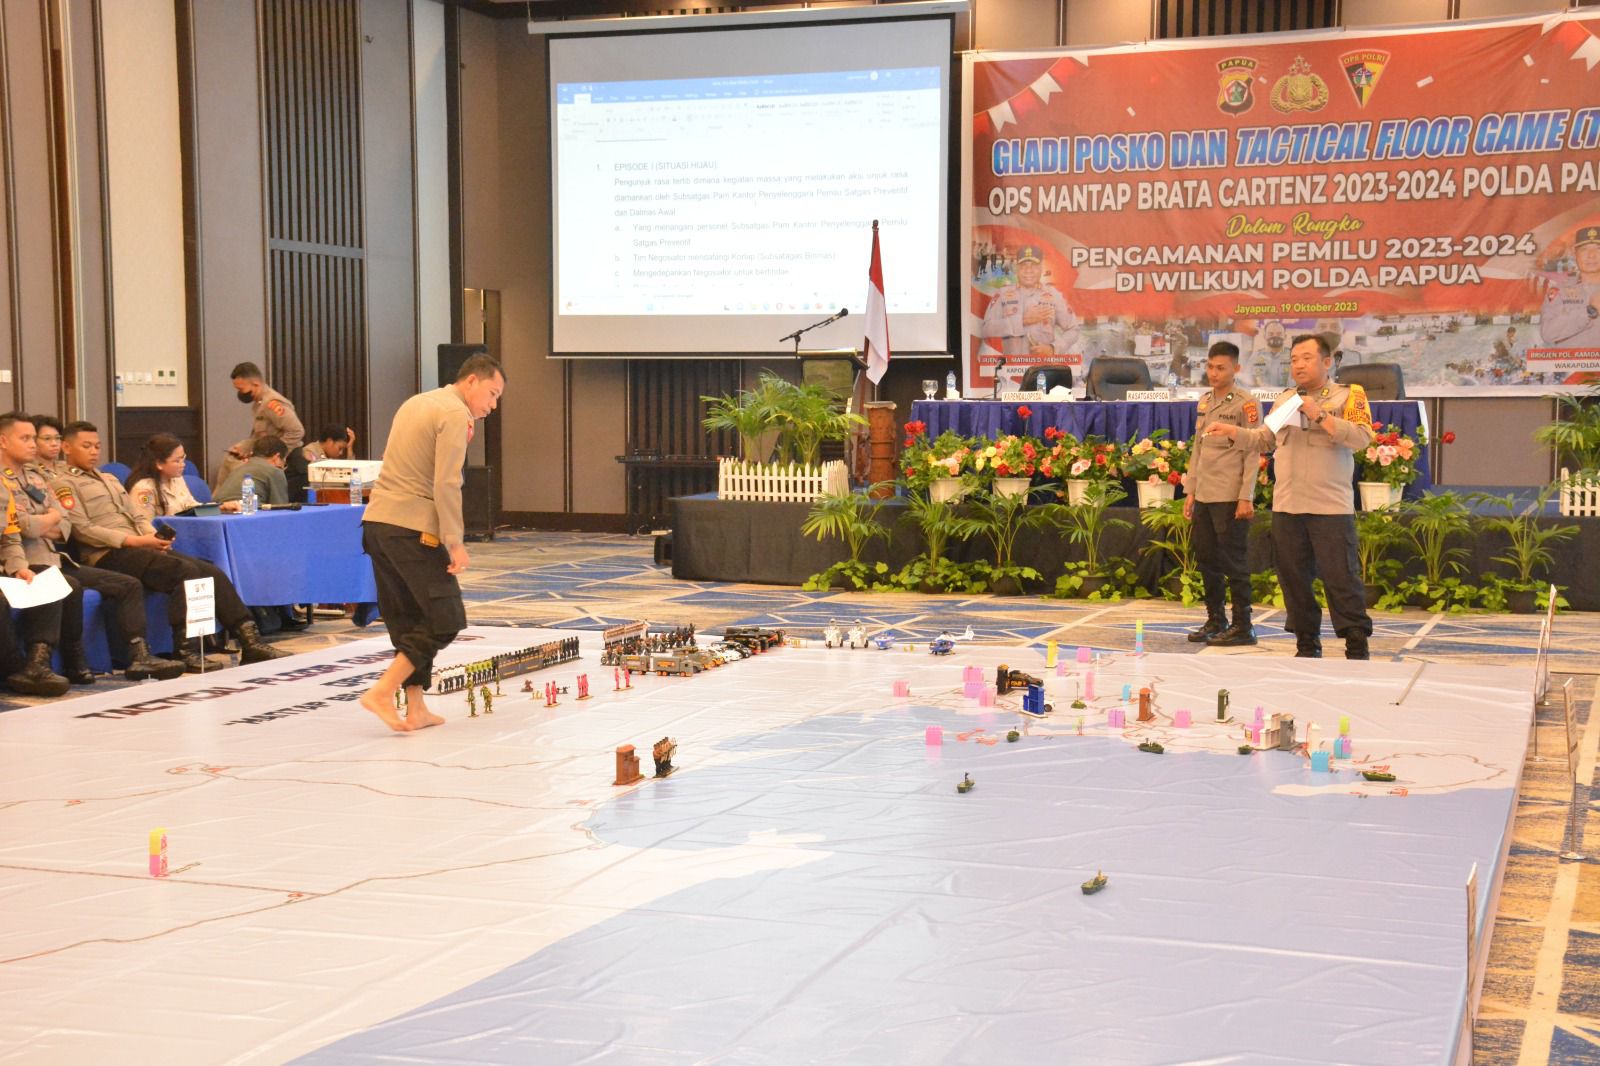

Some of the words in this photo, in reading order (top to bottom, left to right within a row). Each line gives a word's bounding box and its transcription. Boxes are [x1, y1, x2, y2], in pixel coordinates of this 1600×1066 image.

[1362, 53, 1386, 62] POLRI
[1221, 59, 1254, 69] PAPUA
[992, 136, 1070, 176] GLADI
[1074, 132, 1165, 173] POSKO
[1169, 129, 1228, 170] DAN
[1235, 122, 1371, 167] TACTICAL
[1372, 115, 1472, 160] FLOOR
[1473, 109, 1571, 155] GAME
[614, 163, 648, 171] EPISODE
[784, 175, 802, 184] yang
[989, 185, 1032, 215] OPS
[1038, 183, 1131, 213] MANTAP
[1137, 179, 1213, 210] BRATA
[1218, 173, 1328, 208] CARTENZ
[1333, 169, 1456, 203] 2023-2024
[1463, 163, 1553, 198] POLDA
[1561, 160, 1600, 193] PA
[614, 209, 628, 217] dan
[630, 208, 656, 217] Dalmas
[633, 224, 651, 232] Yang
[1226, 213, 1286, 238] Dalam
[1292, 211, 1363, 240] Rangka
[633, 239, 657, 247] Satgas
[1072, 242, 1263, 267] PENGAMANAN
[1272, 239, 1378, 262] PEMILU
[1385, 233, 1536, 260] 2023-2024
[633, 254, 646, 262] Tim
[1116, 272, 1143, 292] DI
[1151, 268, 1264, 291] WILKUM
[1272, 266, 1371, 289] POLDA
[1379, 263, 1481, 286] PAPUA
[1235, 304, 1278, 315] Jayapura,
[1281, 303, 1291, 312] 19
[1294, 302, 1332, 312] Oktober
[1335, 302, 1358, 312] 2023
[1127, 392, 1169, 400] KASATGASOPSDA
